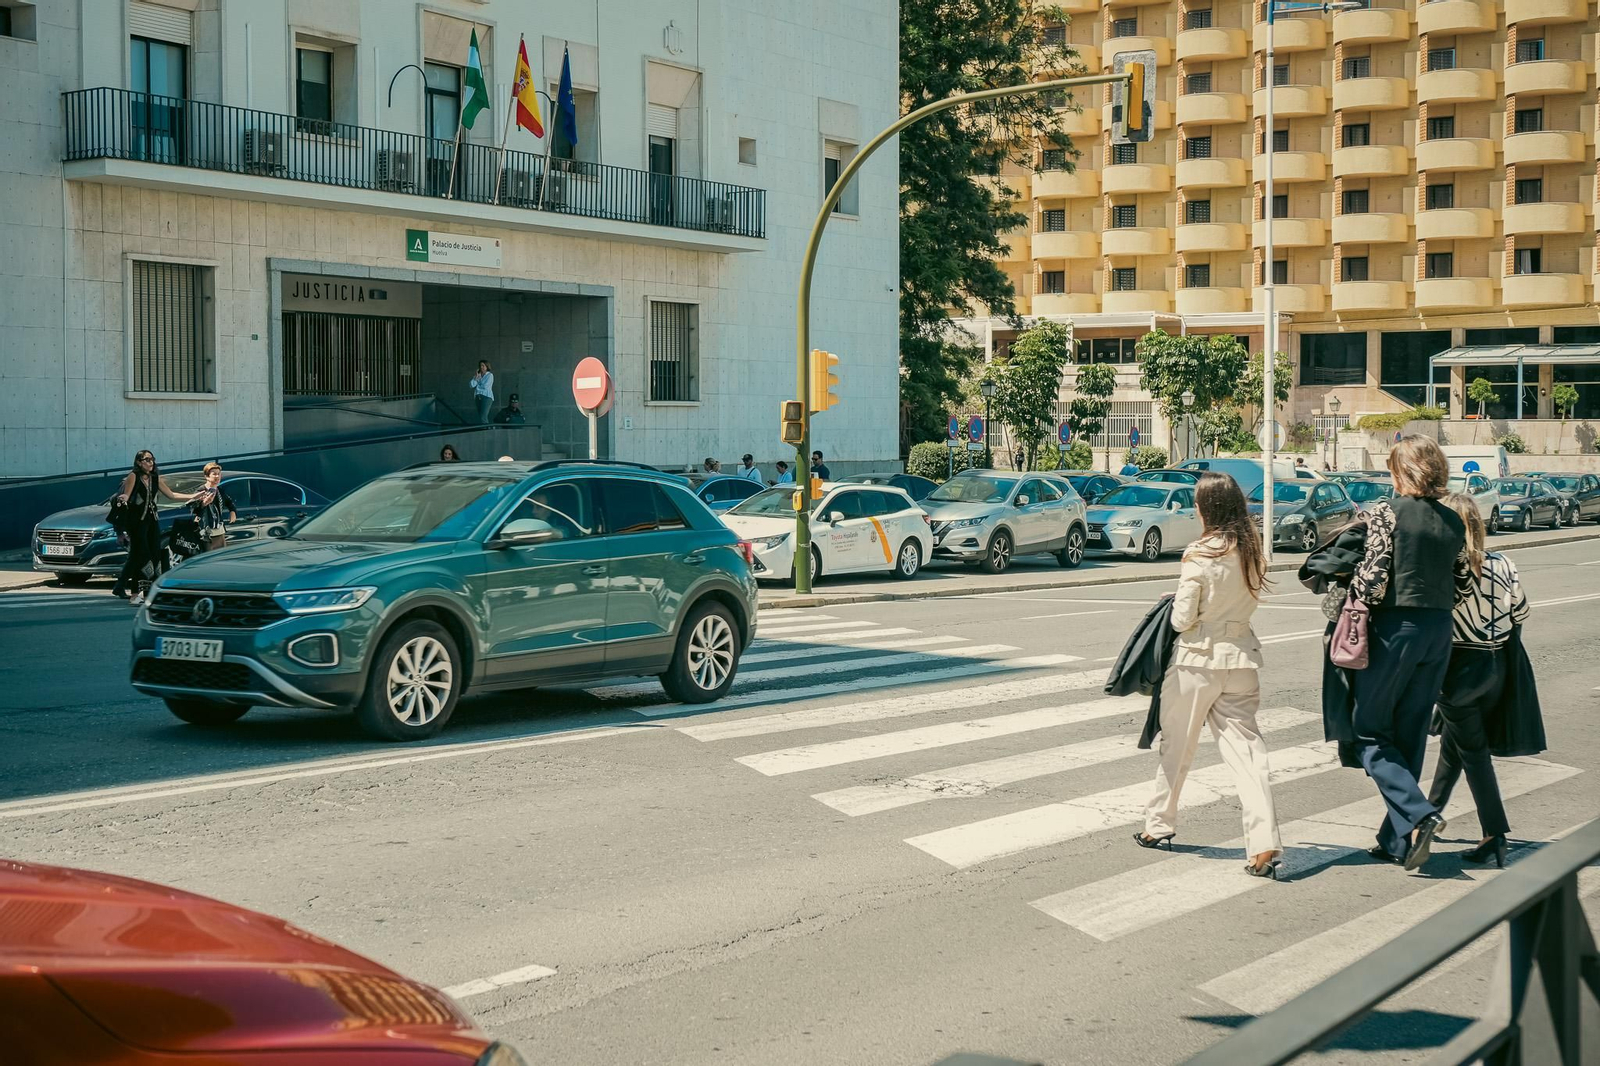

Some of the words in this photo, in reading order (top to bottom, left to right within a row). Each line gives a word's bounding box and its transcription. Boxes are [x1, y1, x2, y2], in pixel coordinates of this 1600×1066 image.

[432, 239, 453, 249] Palacio
[461, 243, 482, 252] Justicia
[292, 281, 365, 302] JUSTICIA
[162, 640, 192, 657] 3703
[194, 642, 219, 658] LZY
